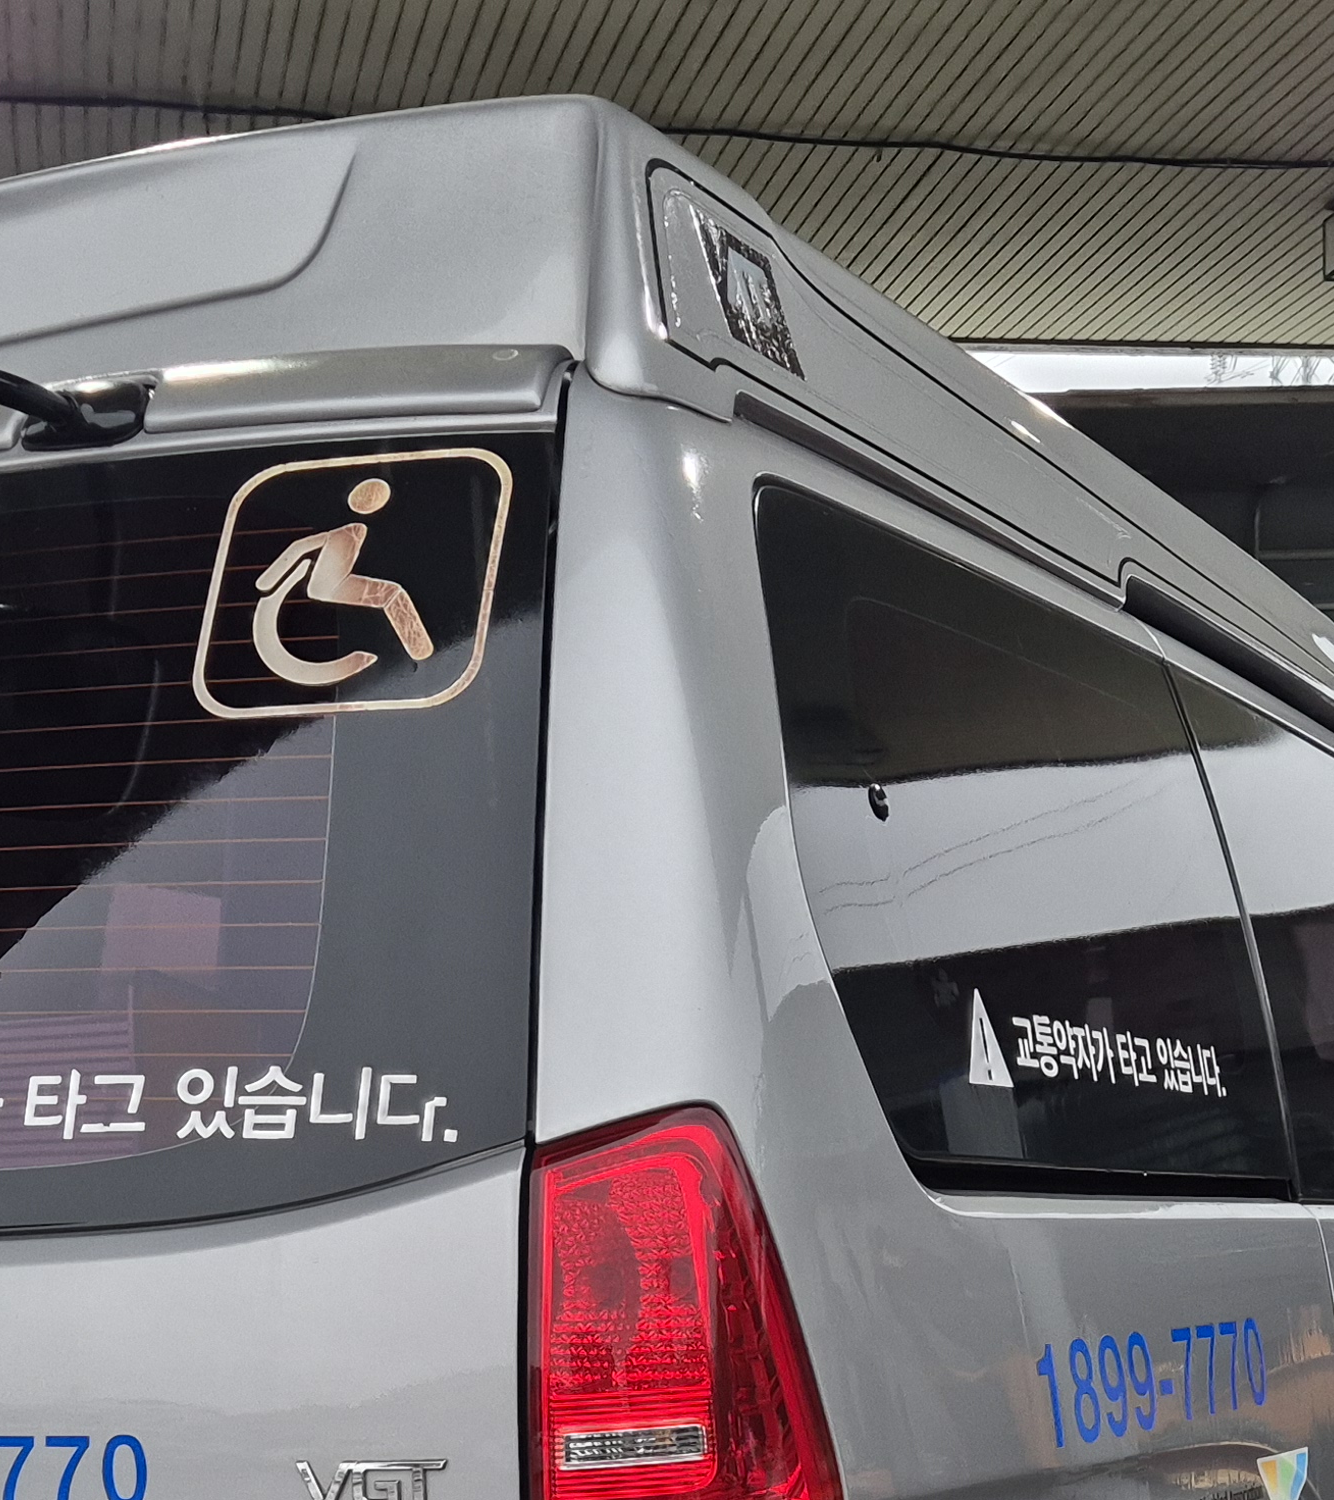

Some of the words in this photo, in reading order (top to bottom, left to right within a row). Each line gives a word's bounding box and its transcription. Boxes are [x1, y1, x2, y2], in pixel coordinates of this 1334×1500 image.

[1012, 1013, 1116, 1085] 교통약자가
[1116, 1030, 1158, 1087] 타고
[1155, 1036, 1228, 1098] 있습니다.
[24, 1068, 147, 1141] 타고
[176, 1065, 461, 1144] 있습니다.
[1035, 1317, 1267, 1449] 1899-7770
